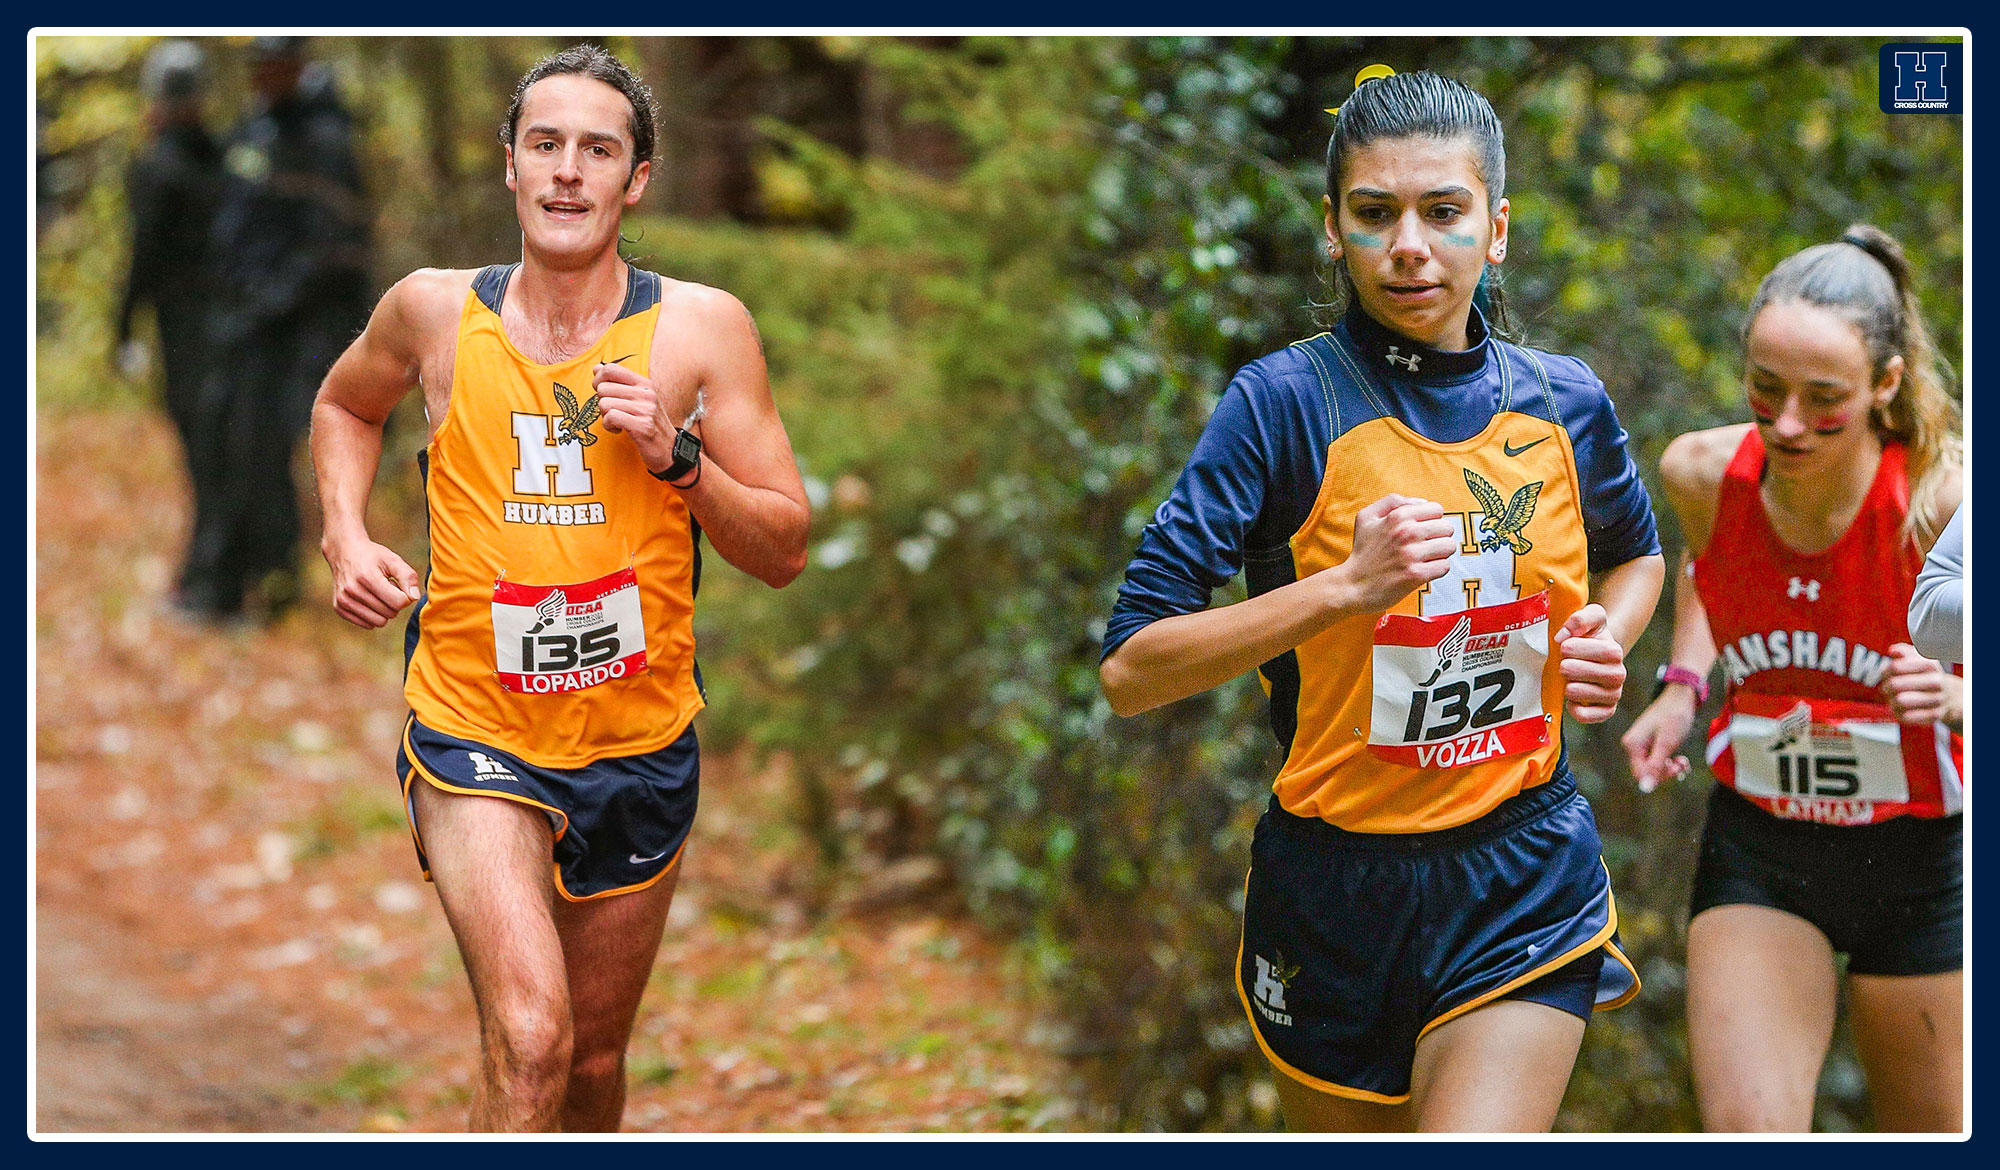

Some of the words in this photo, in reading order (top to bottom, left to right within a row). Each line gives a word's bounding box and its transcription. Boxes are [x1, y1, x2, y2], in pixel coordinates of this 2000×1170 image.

[511, 411, 594, 497] H
[503, 501, 606, 526] HUMBER
[566, 601, 603, 616] OCAA
[596, 591, 609, 599] OCT
[1463, 633, 1510, 653] OCAA
[1504, 623, 1520, 631] OCT
[522, 622, 621, 672] 135
[1722, 630, 1893, 688] ANSHAW
[520, 660, 626, 693] LOPARDO
[1402, 669, 1515, 743] 132
[1416, 729, 1506, 768] VOZZA
[1779, 754, 1860, 797] 115
